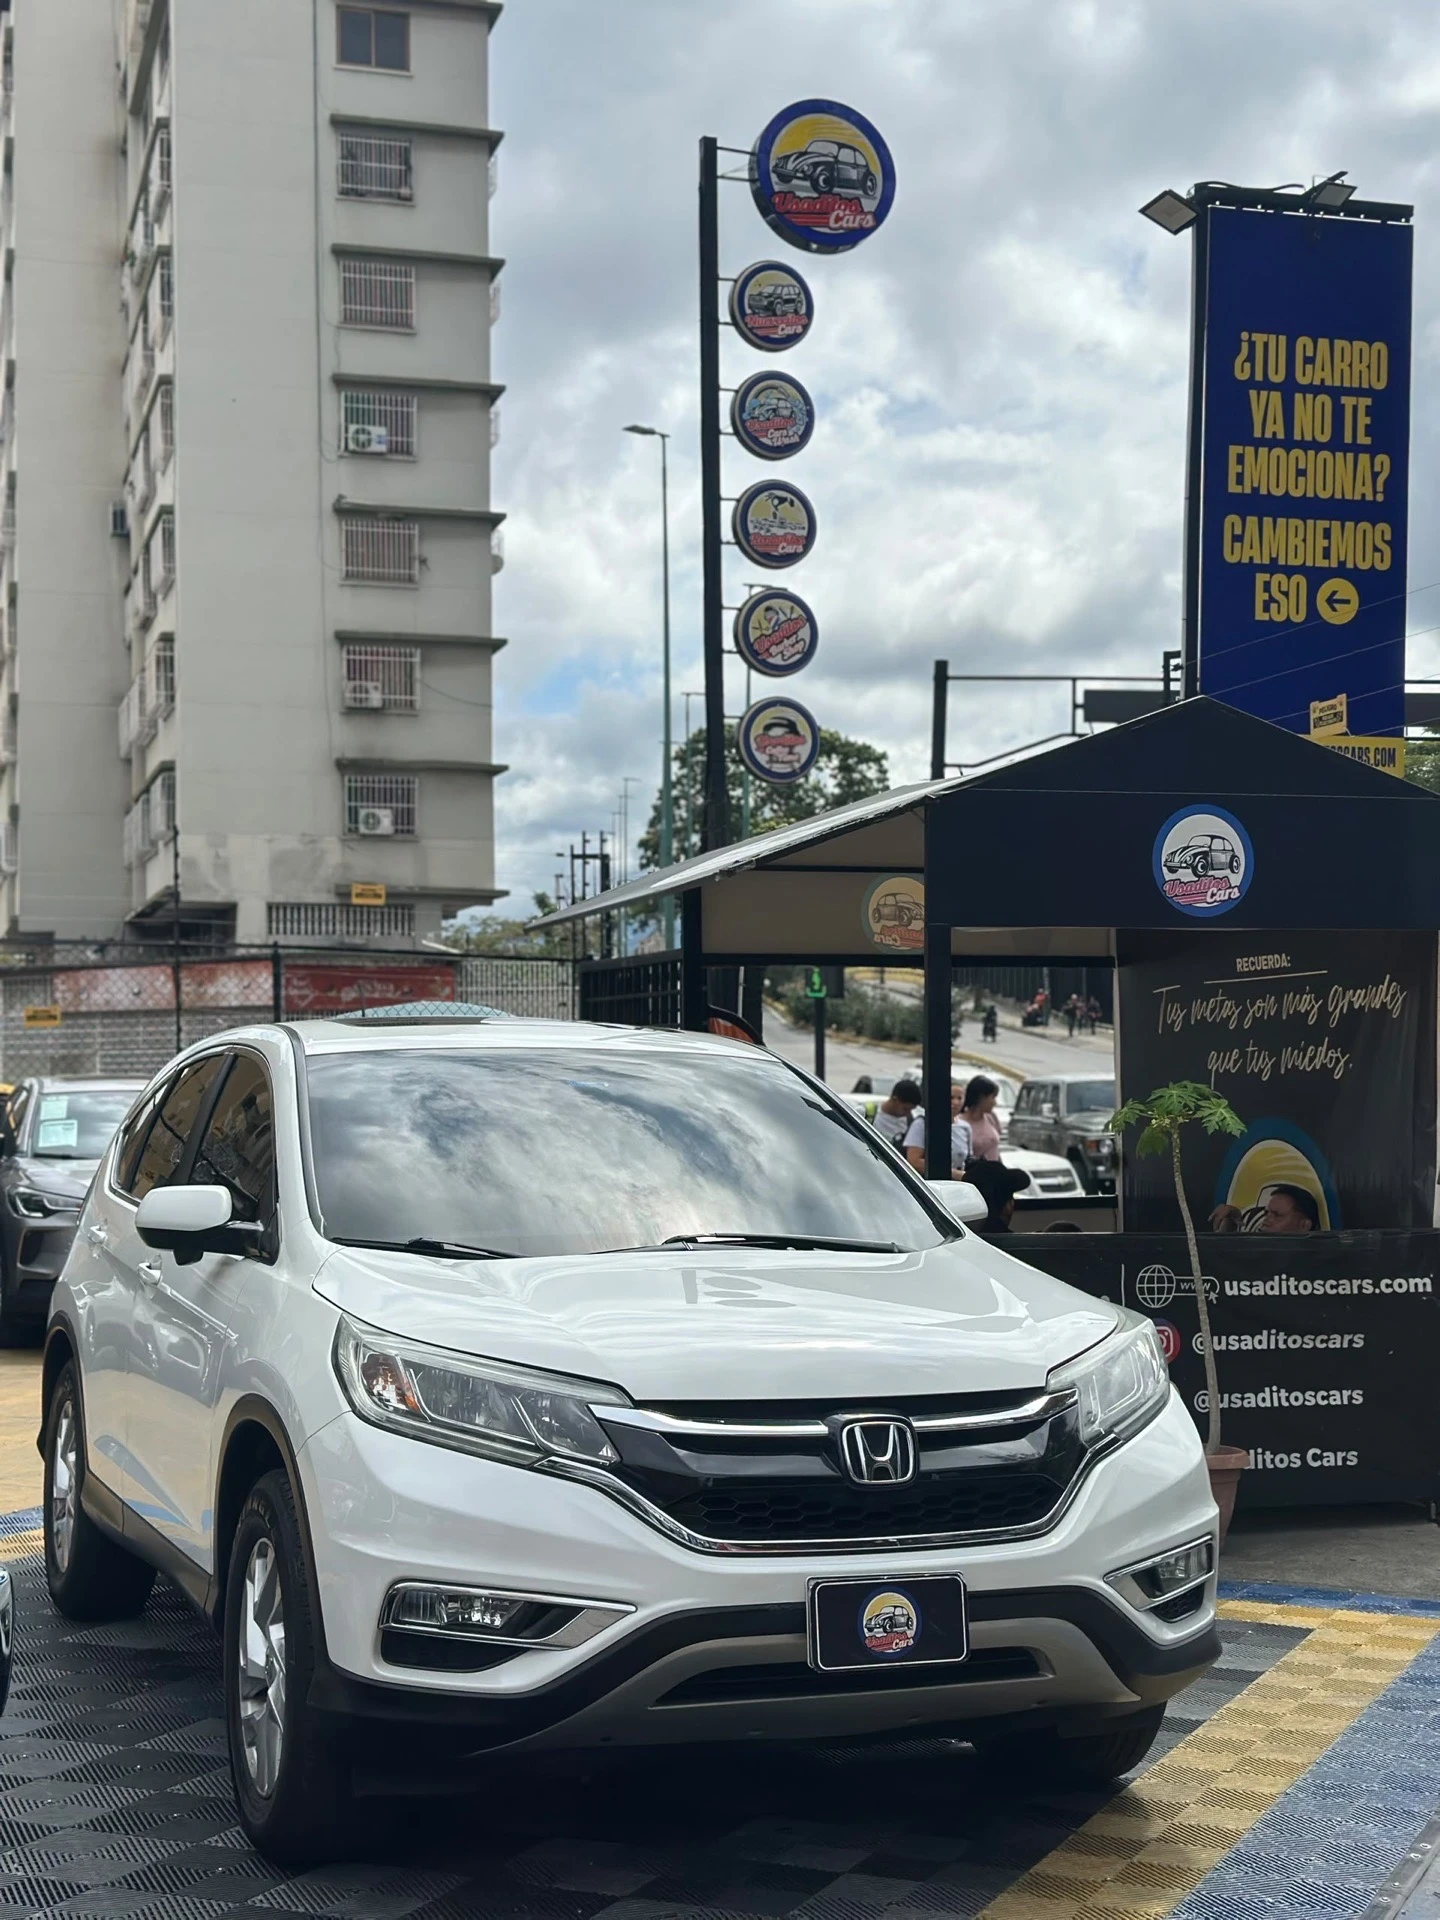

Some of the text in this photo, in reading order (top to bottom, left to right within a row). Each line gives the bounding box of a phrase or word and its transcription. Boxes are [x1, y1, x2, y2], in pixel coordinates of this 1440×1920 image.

[772, 192, 861, 214] Usaditos
[829, 210, 876, 229] Cars
[777, 323, 804, 336] Cars
[1233, 331, 1388, 391] ¿TU CARRO
[1249, 389, 1372, 446] YA NO TE
[1228, 444, 1392, 503] EMOCIONA?
[778, 541, 804, 554] Cars
[1223, 514, 1393, 572] CAMBIEMOS
[1254, 572, 1307, 624] ESO
[1163, 876, 1230, 897] Usaditos
[1206, 886, 1240, 903] Cars
[1236, 953, 1291, 973] RECUERDA:
[1153, 984, 1187, 1034] Tus
[1191, 988, 1243, 1030] metas
[1244, 994, 1278, 1029] son
[1282, 985, 1323, 1026] más
[1207, 1036, 1353, 1091] que tus miedos.
[1224, 1273, 1433, 1297] usaditoscars.com
[1192, 1328, 1366, 1355] @usaditoscars
[1193, 1385, 1365, 1413] @usaditoscars
[1306, 1447, 1359, 1468] Cars
[892, 1638, 914, 1650] Cars
